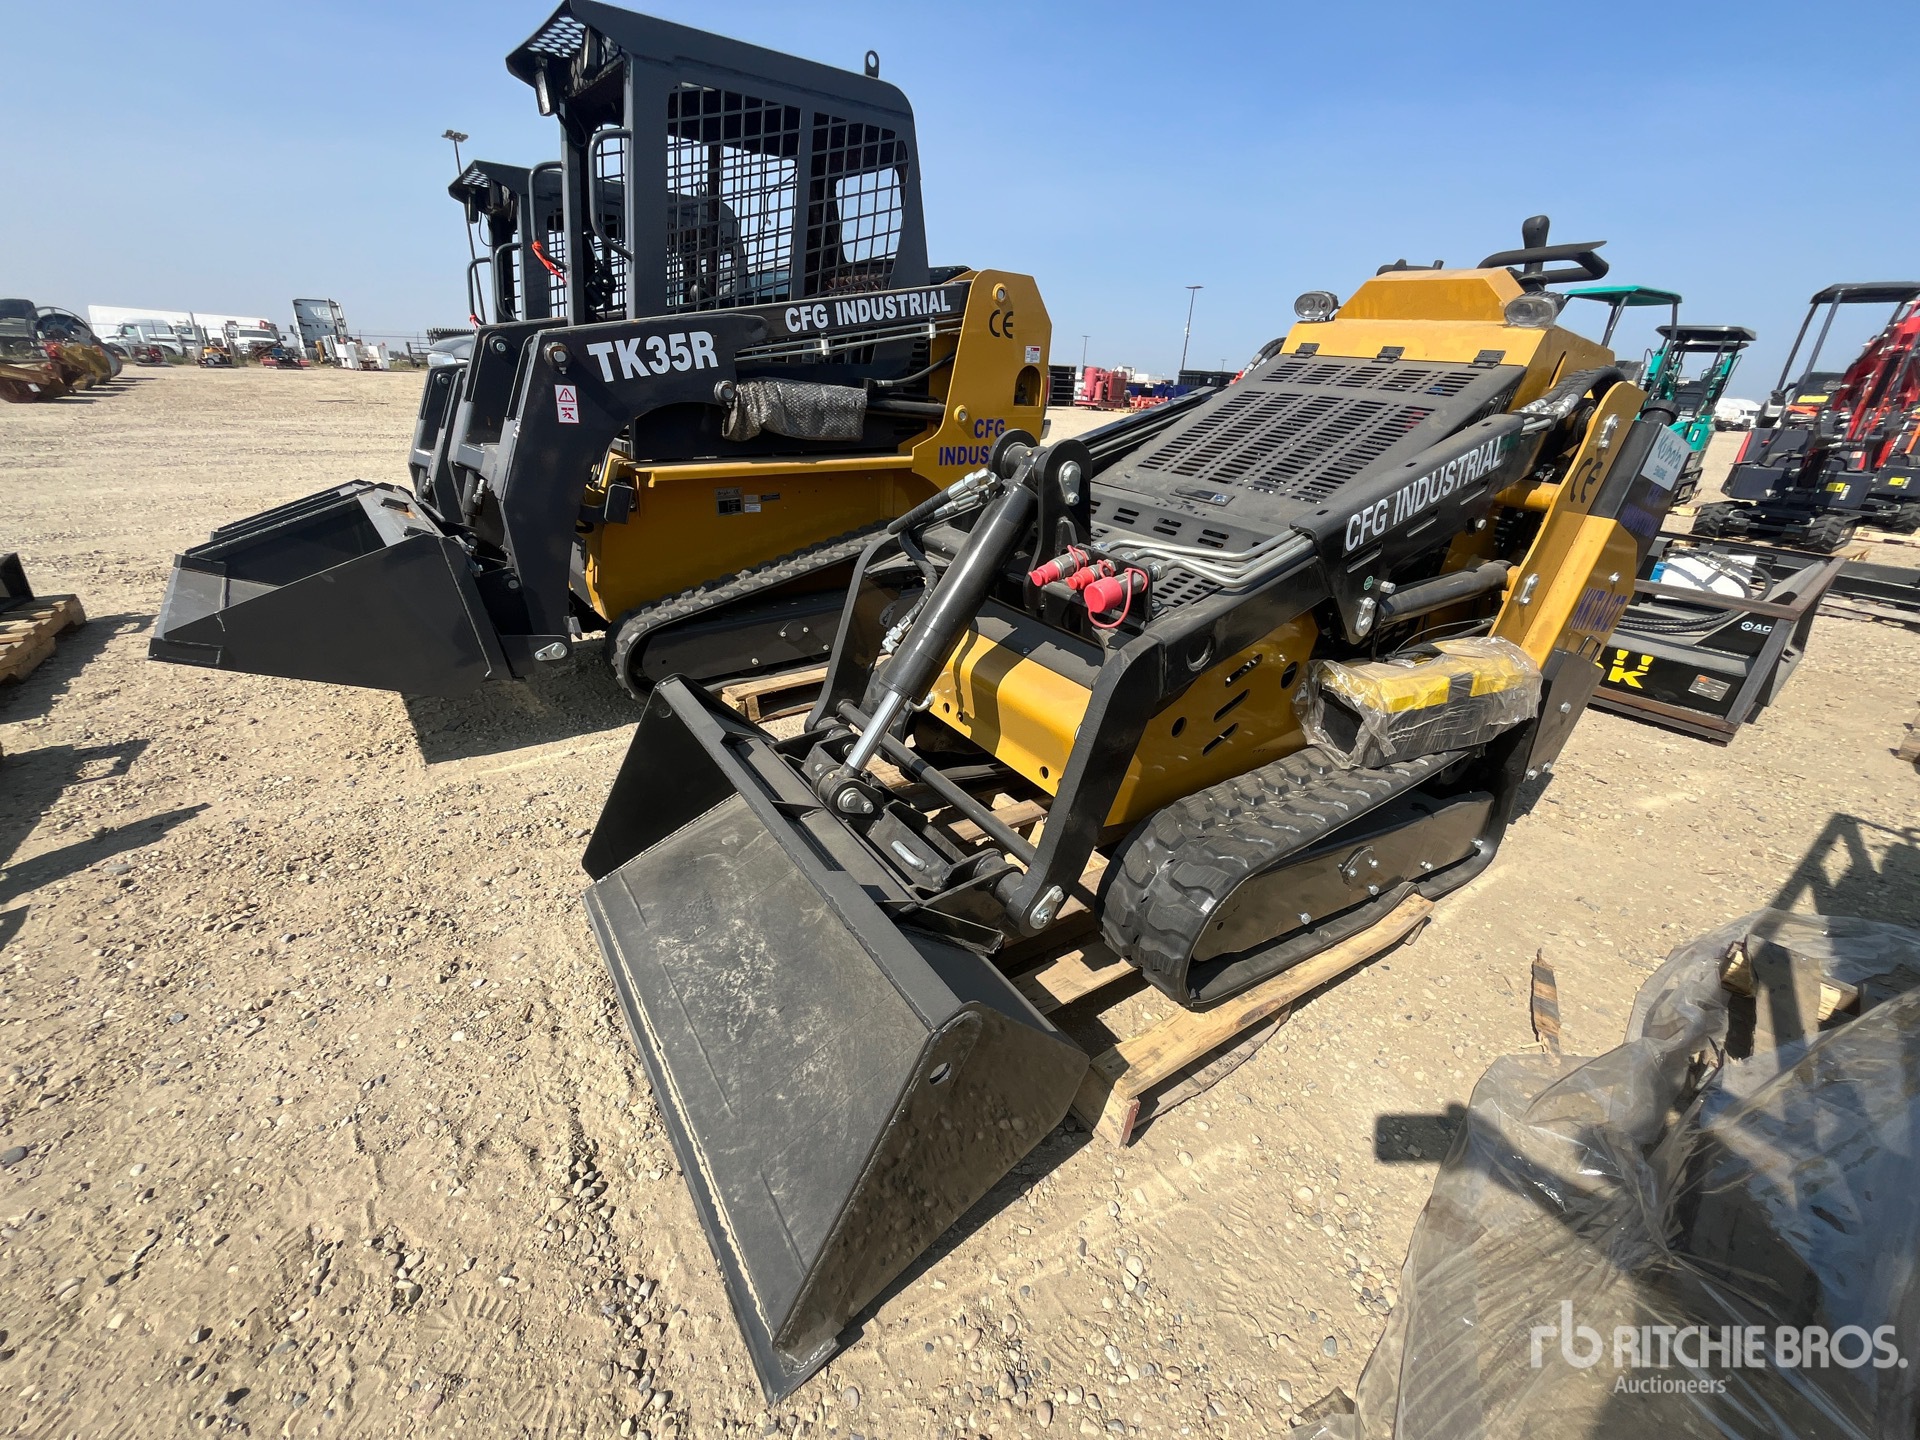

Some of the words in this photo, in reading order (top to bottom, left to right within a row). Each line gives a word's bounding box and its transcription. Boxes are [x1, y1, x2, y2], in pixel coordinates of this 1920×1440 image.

[785, 303, 828, 333] CFG
[836, 290, 951, 326] INDUSTRIAL
[586, 331, 719, 383] TK35R
[974, 418, 1005, 439] CFG
[938, 445, 992, 466] INDUS
[1345, 498, 1389, 552] CFG
[1392, 435, 1503, 526] INDUSTRIAL
